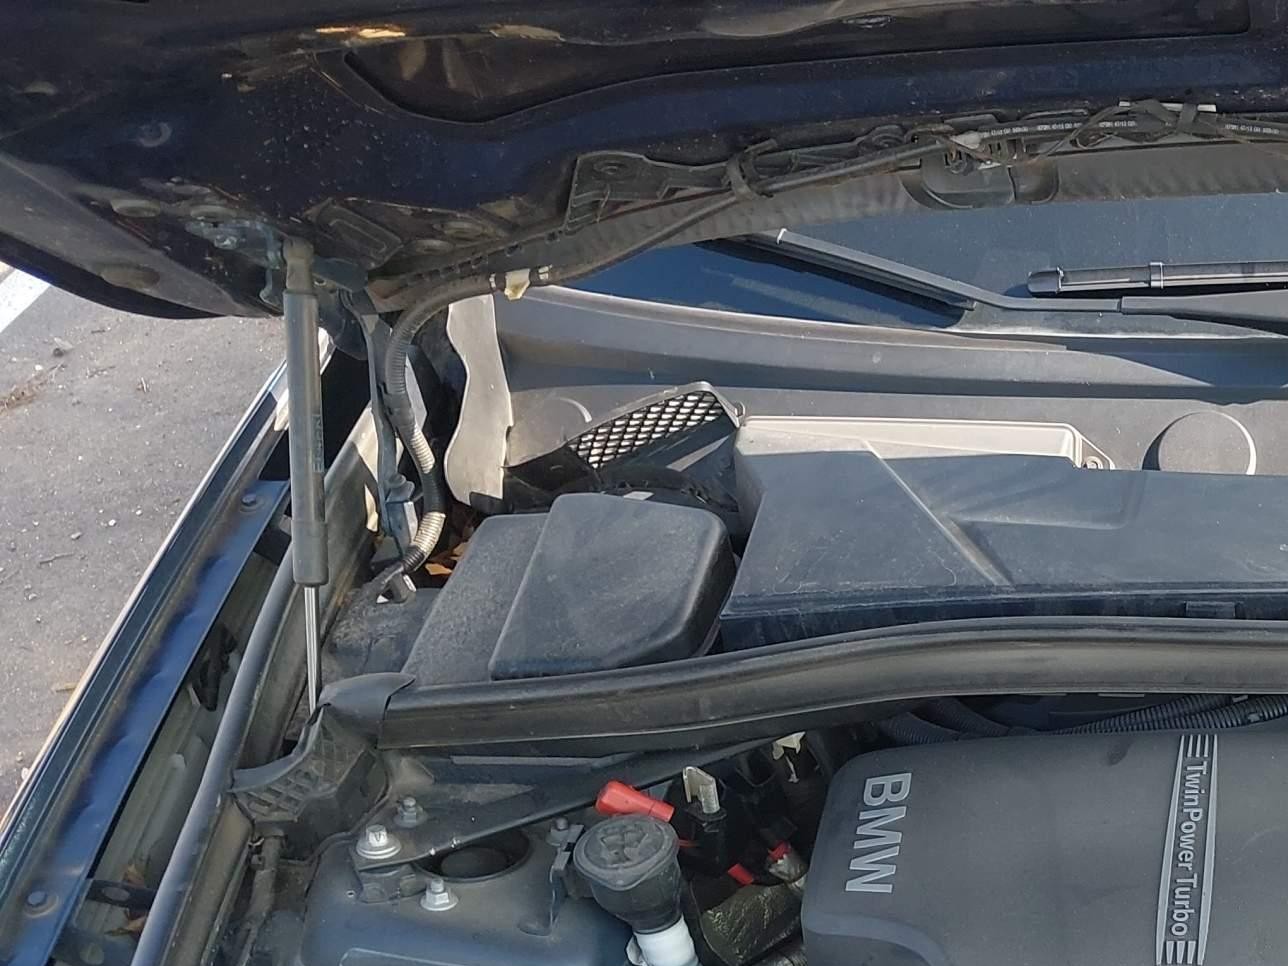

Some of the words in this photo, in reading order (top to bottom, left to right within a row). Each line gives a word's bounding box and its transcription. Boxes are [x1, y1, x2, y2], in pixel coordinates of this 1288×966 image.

[845, 772, 913, 894] BMW
[1175, 760, 1208, 871] TwinPower
[1169, 873, 1198, 937] Turbo
